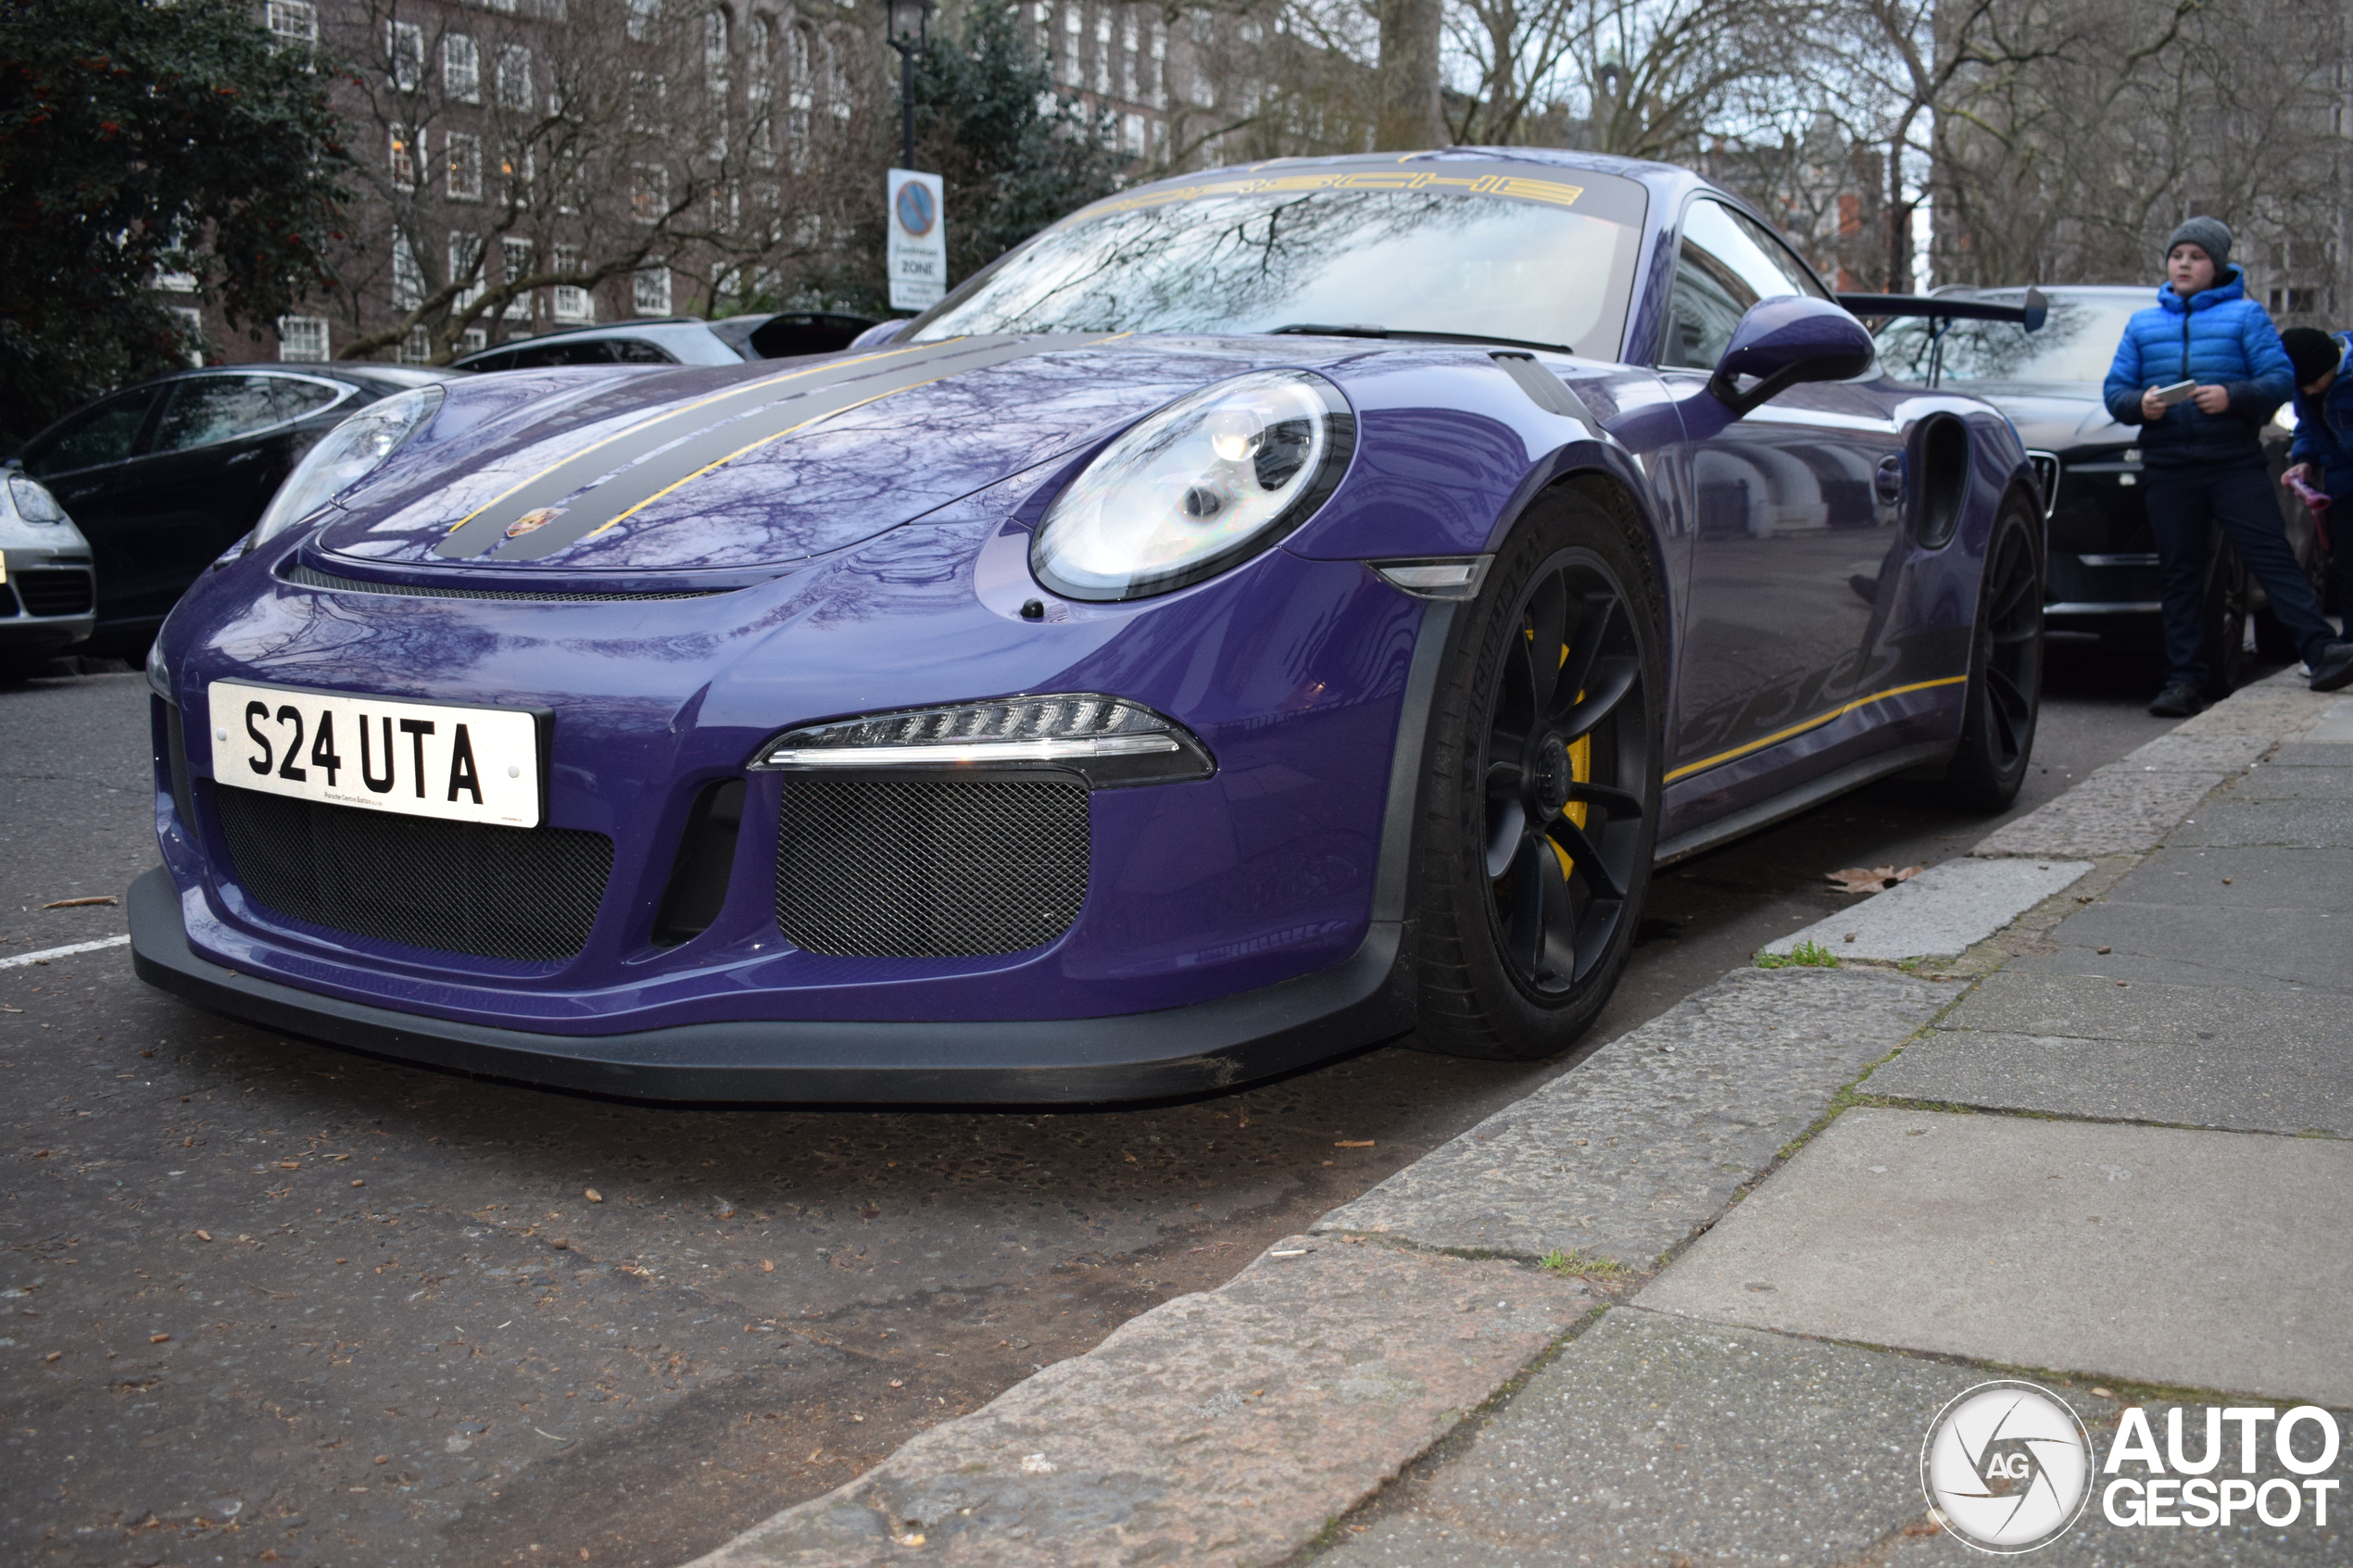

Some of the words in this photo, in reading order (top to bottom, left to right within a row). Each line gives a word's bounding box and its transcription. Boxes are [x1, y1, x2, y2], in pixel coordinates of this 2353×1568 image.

[902, 259, 934, 275] ZONE
[245, 700, 341, 786] S24
[359, 714, 484, 805] UTA
